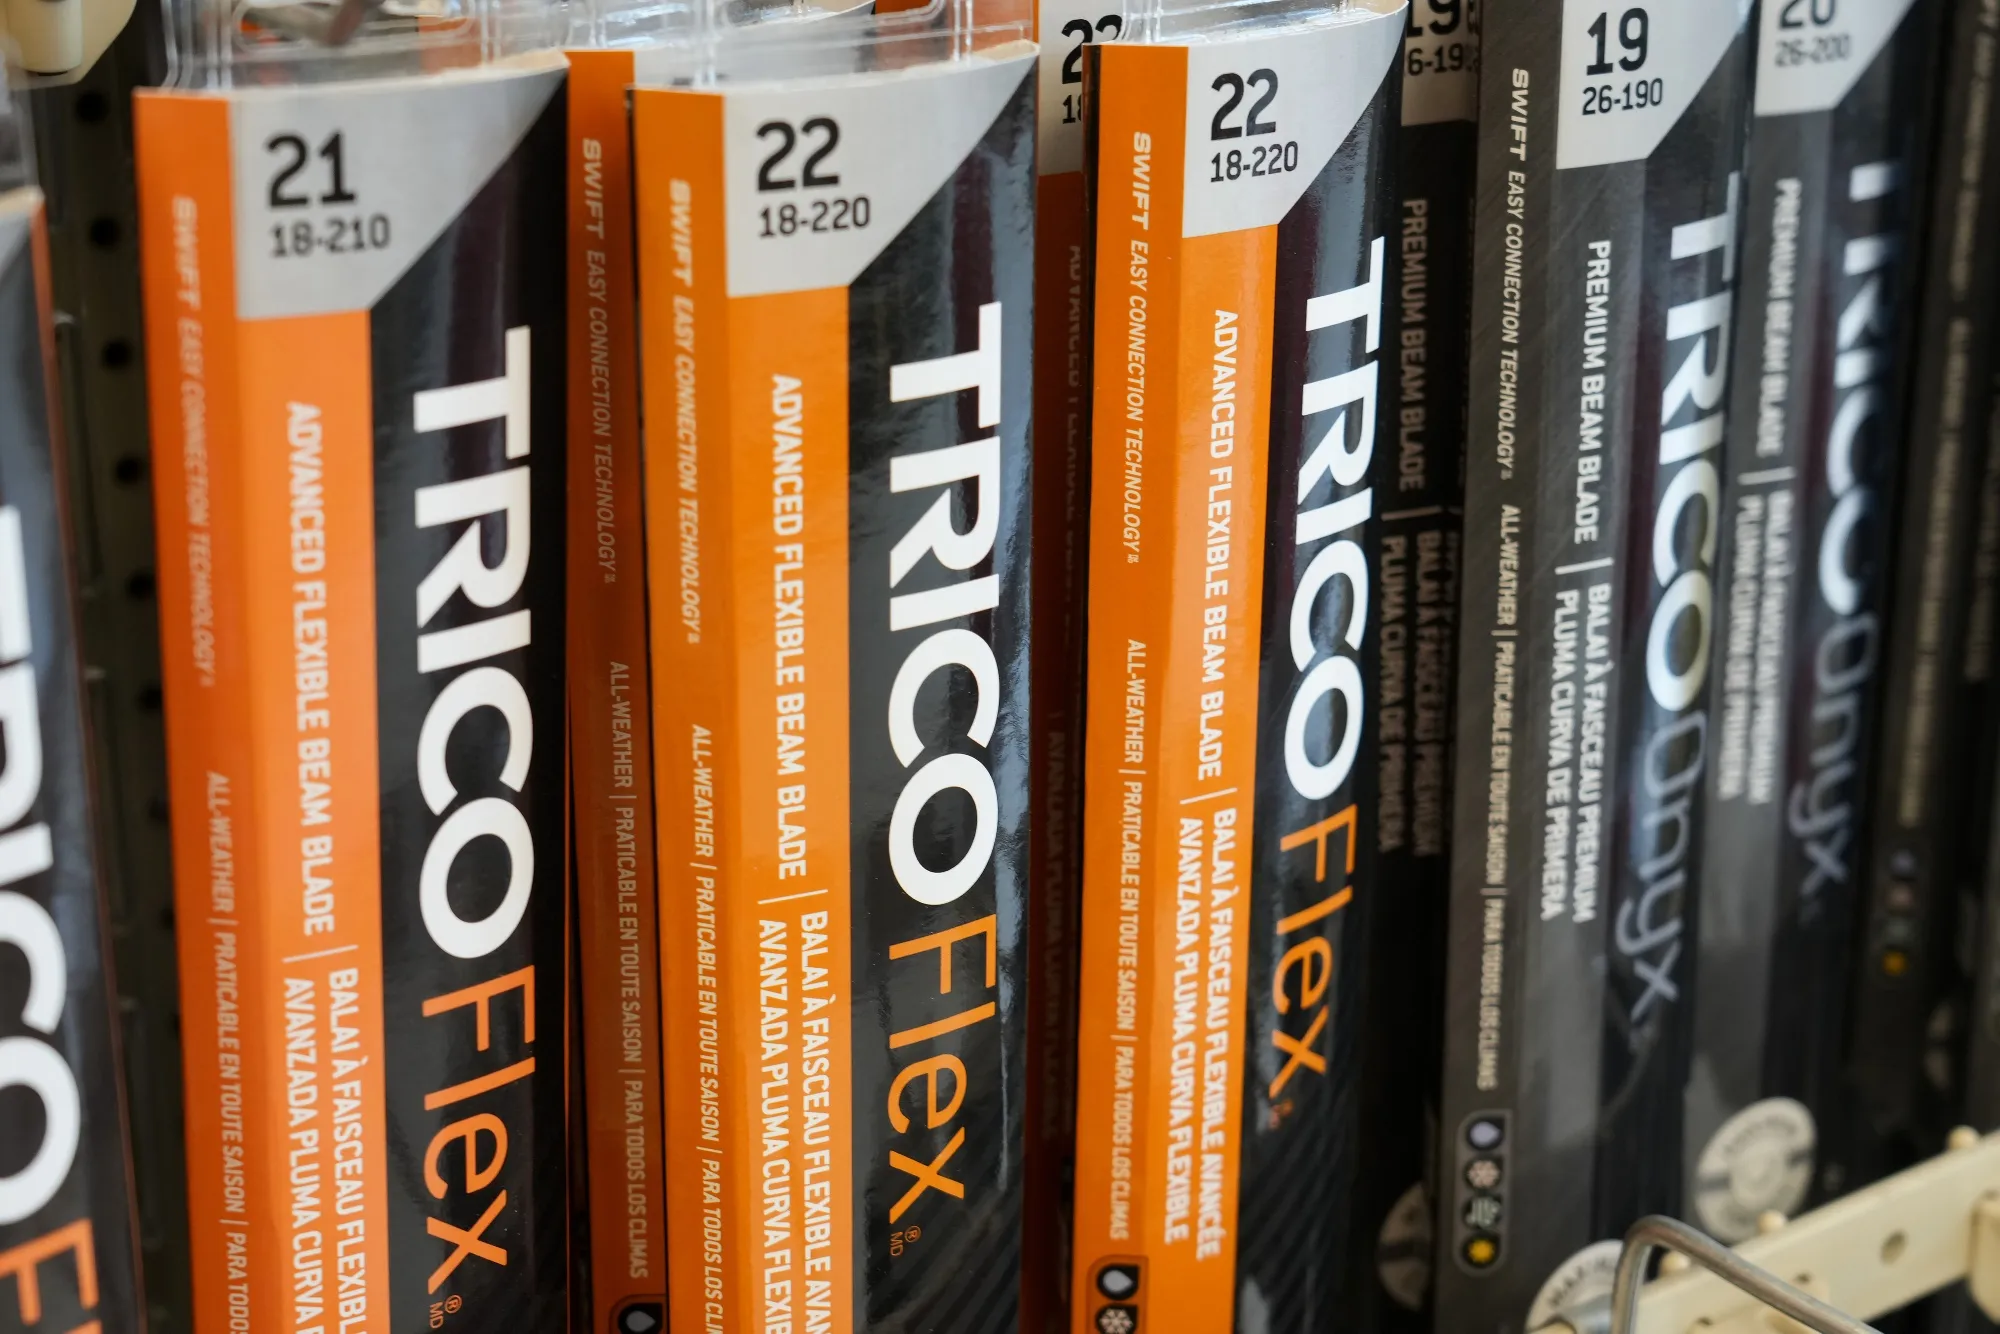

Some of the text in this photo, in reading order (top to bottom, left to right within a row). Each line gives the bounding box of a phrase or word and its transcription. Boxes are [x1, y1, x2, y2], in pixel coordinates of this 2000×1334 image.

[1582, 78, 1663, 115] 26-190
[1586, 8, 1650, 76] 19
[756, 117, 841, 192] 22
[1210, 68, 1279, 141] 22
[1508, 68, 1530, 161] SWIFT
[266, 130, 357, 207] 21
[582, 138, 605, 239] SWIFT
[759, 197, 870, 239] 18-220
[1131, 132, 1152, 230] SWIFT
[1210, 141, 1299, 183] 18-220
[1506, 170, 1526, 219] EASY
[271, 213, 391, 258] 18-210
[586, 250, 607, 303] EASY
[669, 179, 694, 287] SWIFT
[1129, 240, 1149, 292] EASY
[1501, 223, 1524, 343] CONNECTION
[587, 307, 612, 437] CONNECTION
[672, 295, 695, 351] EASY
[1126, 295, 1148, 420] CONNECTION
[1399, 199, 1429, 491] PREMIUM BEAM BLADE
[673, 354, 698, 492] CONNECTION
[1496, 349, 1520, 468] TECHNOLOGY
[1573, 240, 1613, 544] PREMIUM BEAM BLADE
[1646, 171, 1739, 711] TRICO
[592, 443, 617, 571] TECHNOLOGY
[1122, 427, 1144, 552] TECHNOLOGY
[1198, 310, 1240, 780] ADVANCED FLEXIBLE BEAM BLADE
[1284, 236, 1384, 799] TRICO
[677, 498, 701, 631] TECHNOLOGY
[888, 301, 1001, 906] TRICO
[1495, 504, 1521, 625] ALL-WEATHER
[1584, 583, 1613, 659] BALAI
[286, 402, 336, 936] ADVANCED FLEXIBLE BEAM BLADE
[414, 326, 535, 958] TRICO
[771, 374, 807, 880] ADVANCED FLEXIBLE BEAM BLADE
[691, 724, 714, 856] ALL-WEATHER
[1540, 589, 1581, 921] PLUMA CURVA DE PRIMERA
[1577, 682, 1608, 803] FAISCEAU
[206, 771, 236, 912] ALL-WEATHER
[1210, 808, 1238, 884] BALAI
[1572, 804, 1602, 923] PREMIUM
[608, 662, 649, 1278] ALL-WEATHER PRATICABLE EN TOUTE SAISON PARA TODOS LOS CLIMAS
[694, 876, 717, 986] PRATICABLE
[800, 910, 830, 990] BALAI
[1108, 639, 1146, 1240] ALL-WEATHER PRATICABLE EN TOUTE SAISON PARA TODOS LOS CLIMAS
[1205, 908, 1234, 1029] FAISCEAU
[1268, 803, 1357, 1099] Flex
[213, 932, 241, 1048] PRATICABLE
[327, 968, 363, 1053] BALAI
[697, 989, 718, 1014] EN
[697, 1018, 719, 1073] TOUTE
[758, 919, 789, 1060] AVANZADA
[801, 993, 837, 1016] À
[1164, 817, 1206, 1244] AVANZADA PLUMA CURVA FLEXIBLE
[218, 1053, 242, 1079] EN
[282, 977, 320, 1127] AVANZADA
[699, 1076, 721, 1141] SAISON
[801, 1018, 831, 1145] FAISCEAU
[887, 914, 996, 1225] Flex
[1200, 1030, 1230, 1151] FLEXIBLE
[219, 1083, 244, 1141] TOUTE
[329, 1080, 366, 1215] FAISCEAU
[421, 965, 536, 1295] Flex
[760, 1063, 791, 1156] PLUMA
[222, 1145, 247, 1212] SAISON
[287, 1129, 323, 1228] PLUMA
[701, 1158, 722, 1204] PARA
[702, 1207, 723, 1263] TODOS
[761, 1159, 792, 1247] CURVA
[802, 1150, 832, 1275] FLEXIBLE
[1196, 1153, 1228, 1261] AVANCÉE
[226, 1231, 249, 1279] PARA
[290, 1230, 326, 1324] CURVA
[333, 1220, 368, 1334] FLEXIBL
[703, 1266, 724, 1299] LOS
